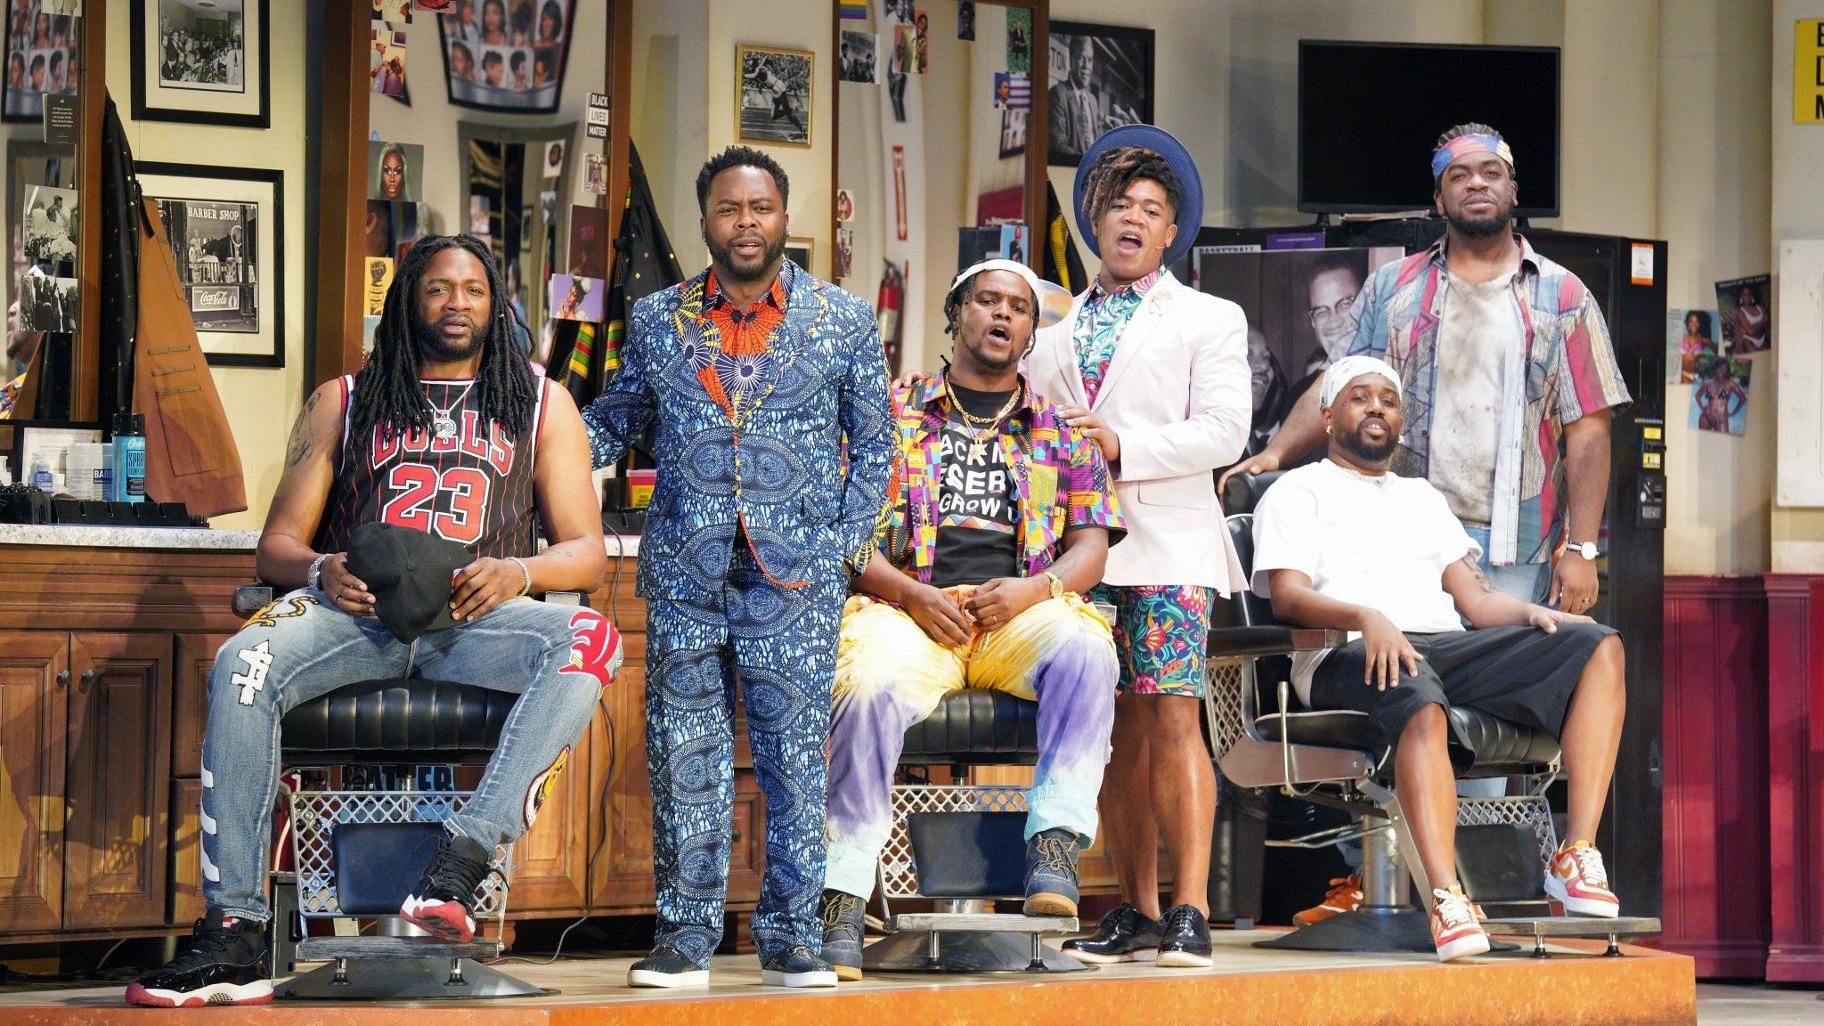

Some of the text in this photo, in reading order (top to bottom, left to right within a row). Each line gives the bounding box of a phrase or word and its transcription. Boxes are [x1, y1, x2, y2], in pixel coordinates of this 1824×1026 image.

[187, 207, 240, 221] BARBER SHOP
[381, 462, 490, 545] 23
[938, 492, 1001, 518] GROW
